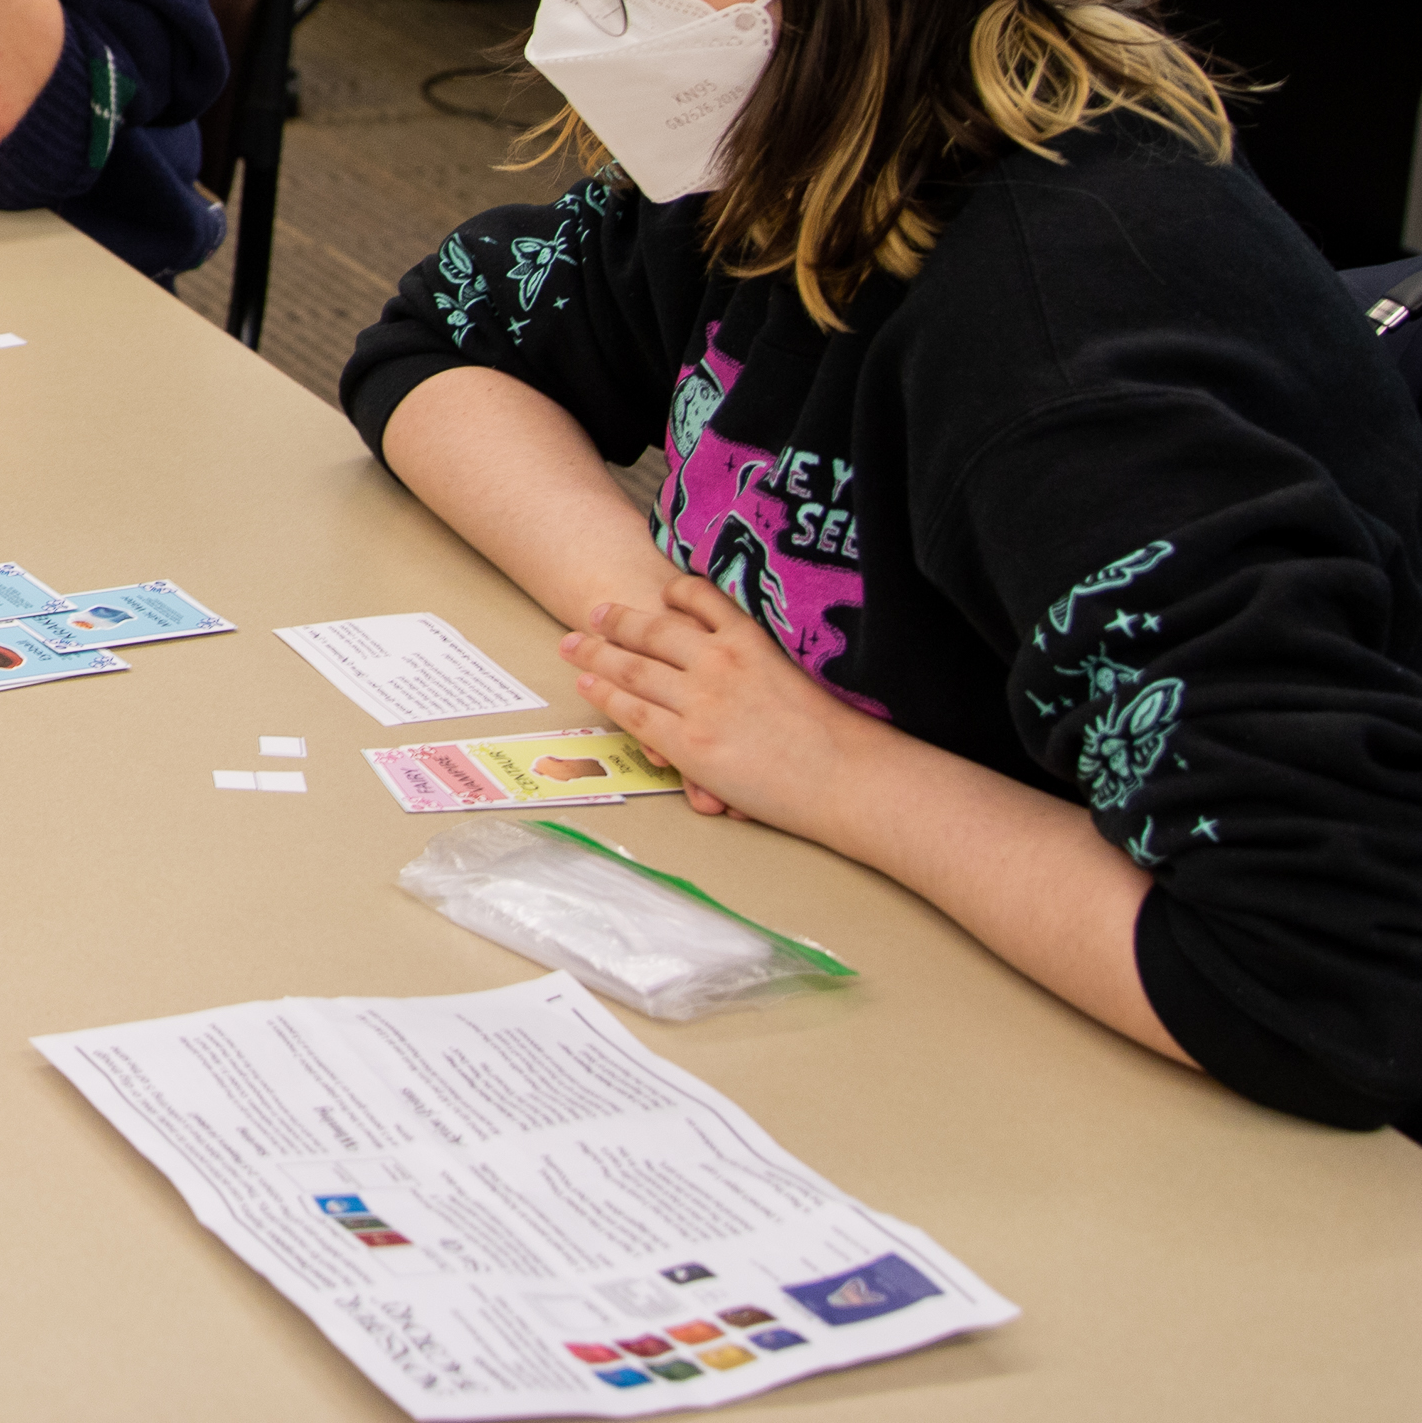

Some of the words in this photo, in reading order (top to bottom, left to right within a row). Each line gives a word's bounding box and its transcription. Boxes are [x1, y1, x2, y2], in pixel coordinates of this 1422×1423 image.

[675, 79, 717, 105] KN95
[33, 615, 77, 640] KRAKE
[402, 767, 437, 795] FAIRY
[436, 755, 484, 793] VAMPIRE
[489, 749, 540, 791] CENTAUR
